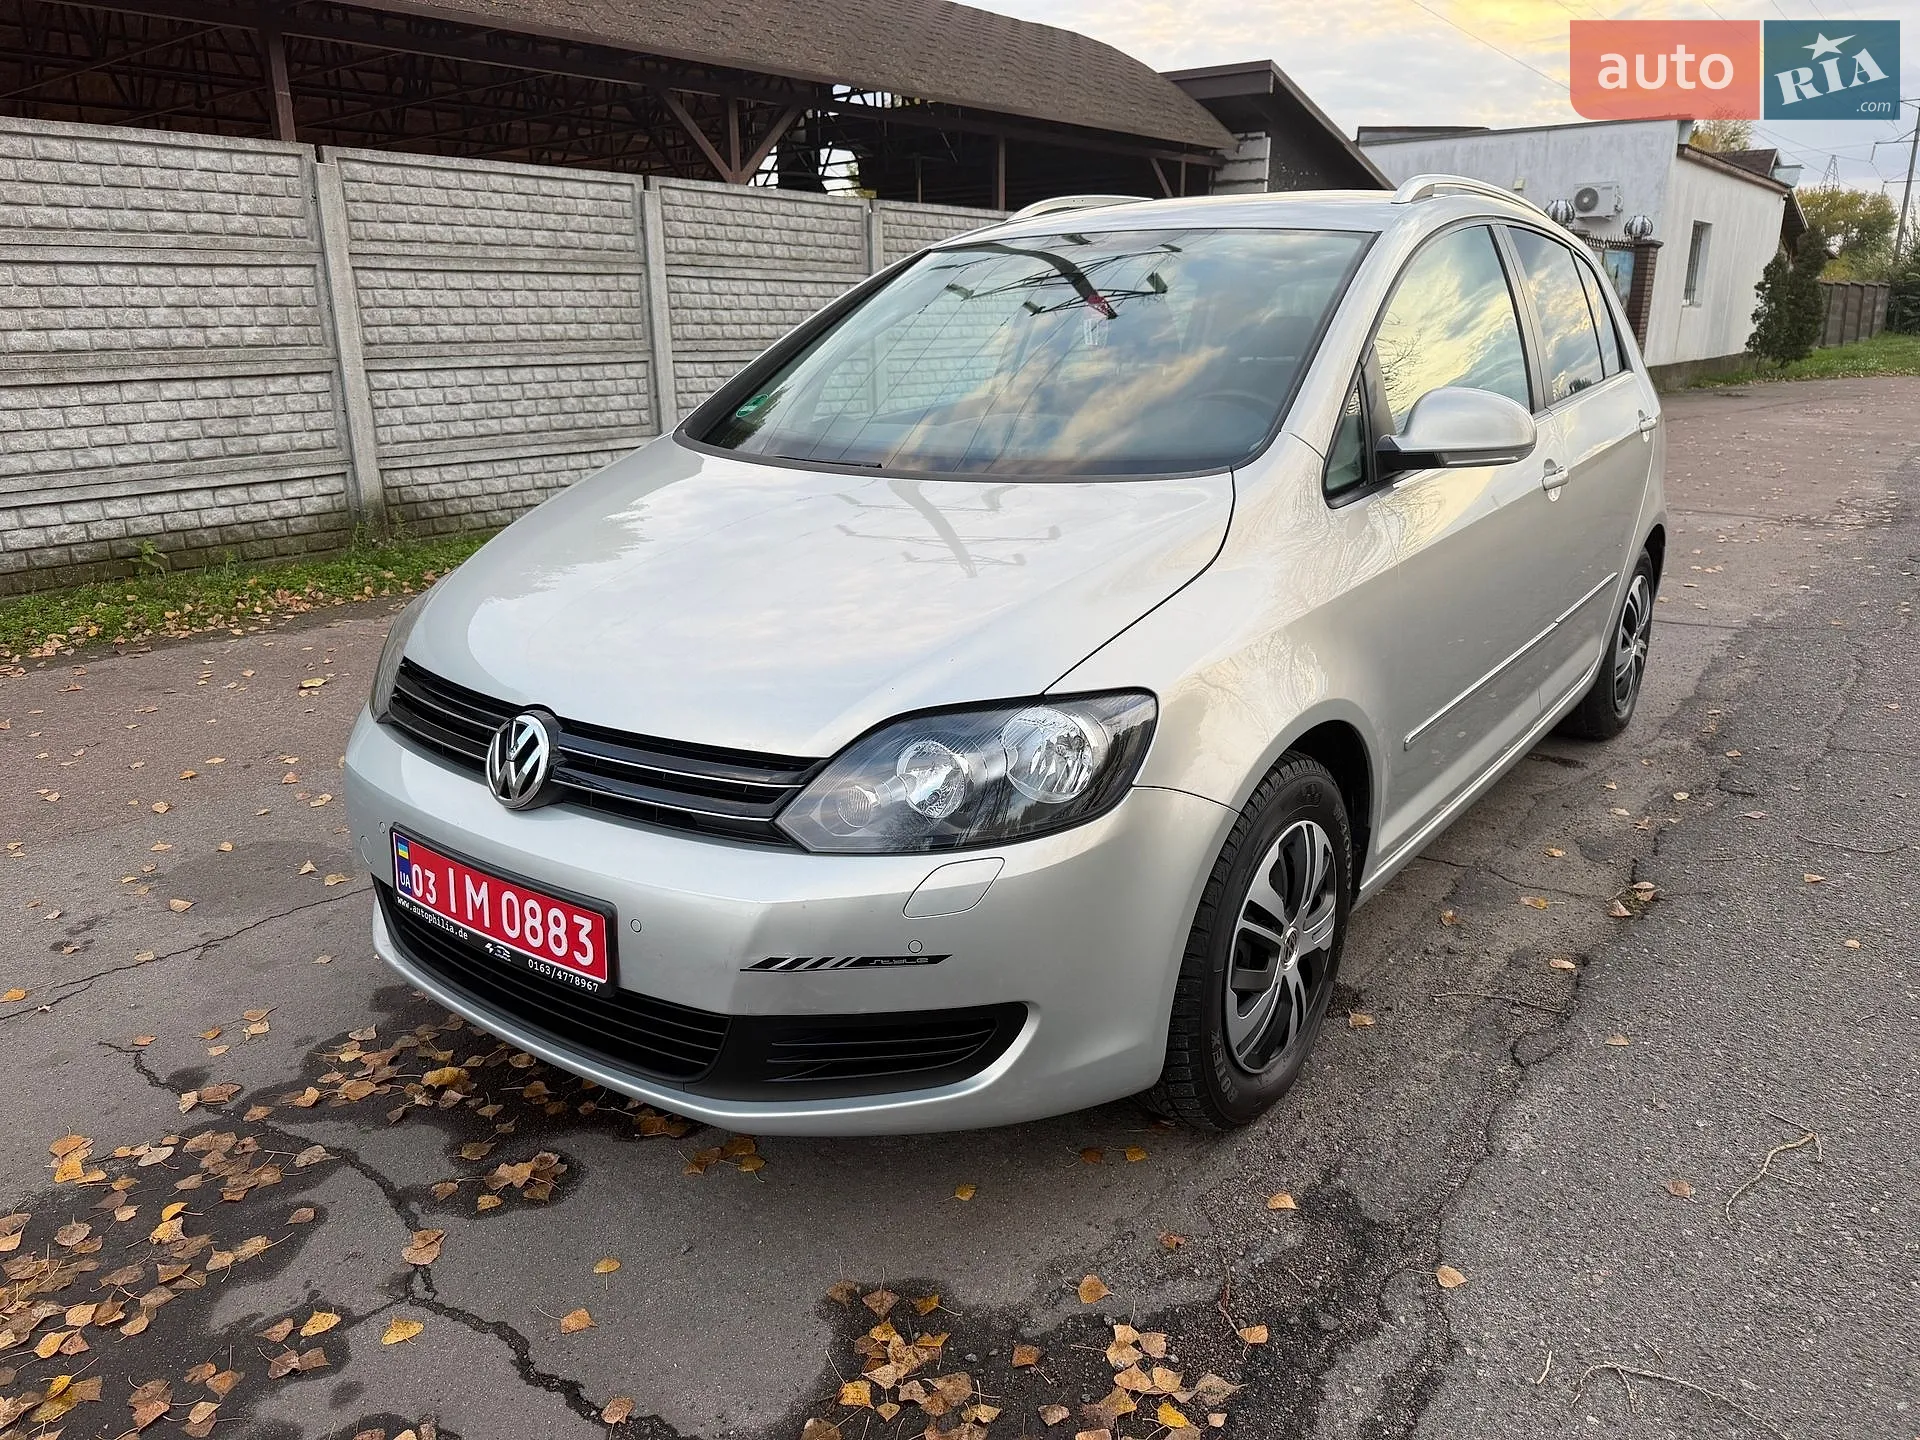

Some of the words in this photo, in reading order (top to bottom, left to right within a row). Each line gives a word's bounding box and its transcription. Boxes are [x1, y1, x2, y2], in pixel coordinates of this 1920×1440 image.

[399, 870, 411, 889] UA
[397, 896, 468, 940] www.autophilia.de
[411, 863, 437, 905] 03
[501, 890, 594, 967] 0883
[527, 958, 599, 993] 0163/4778967
